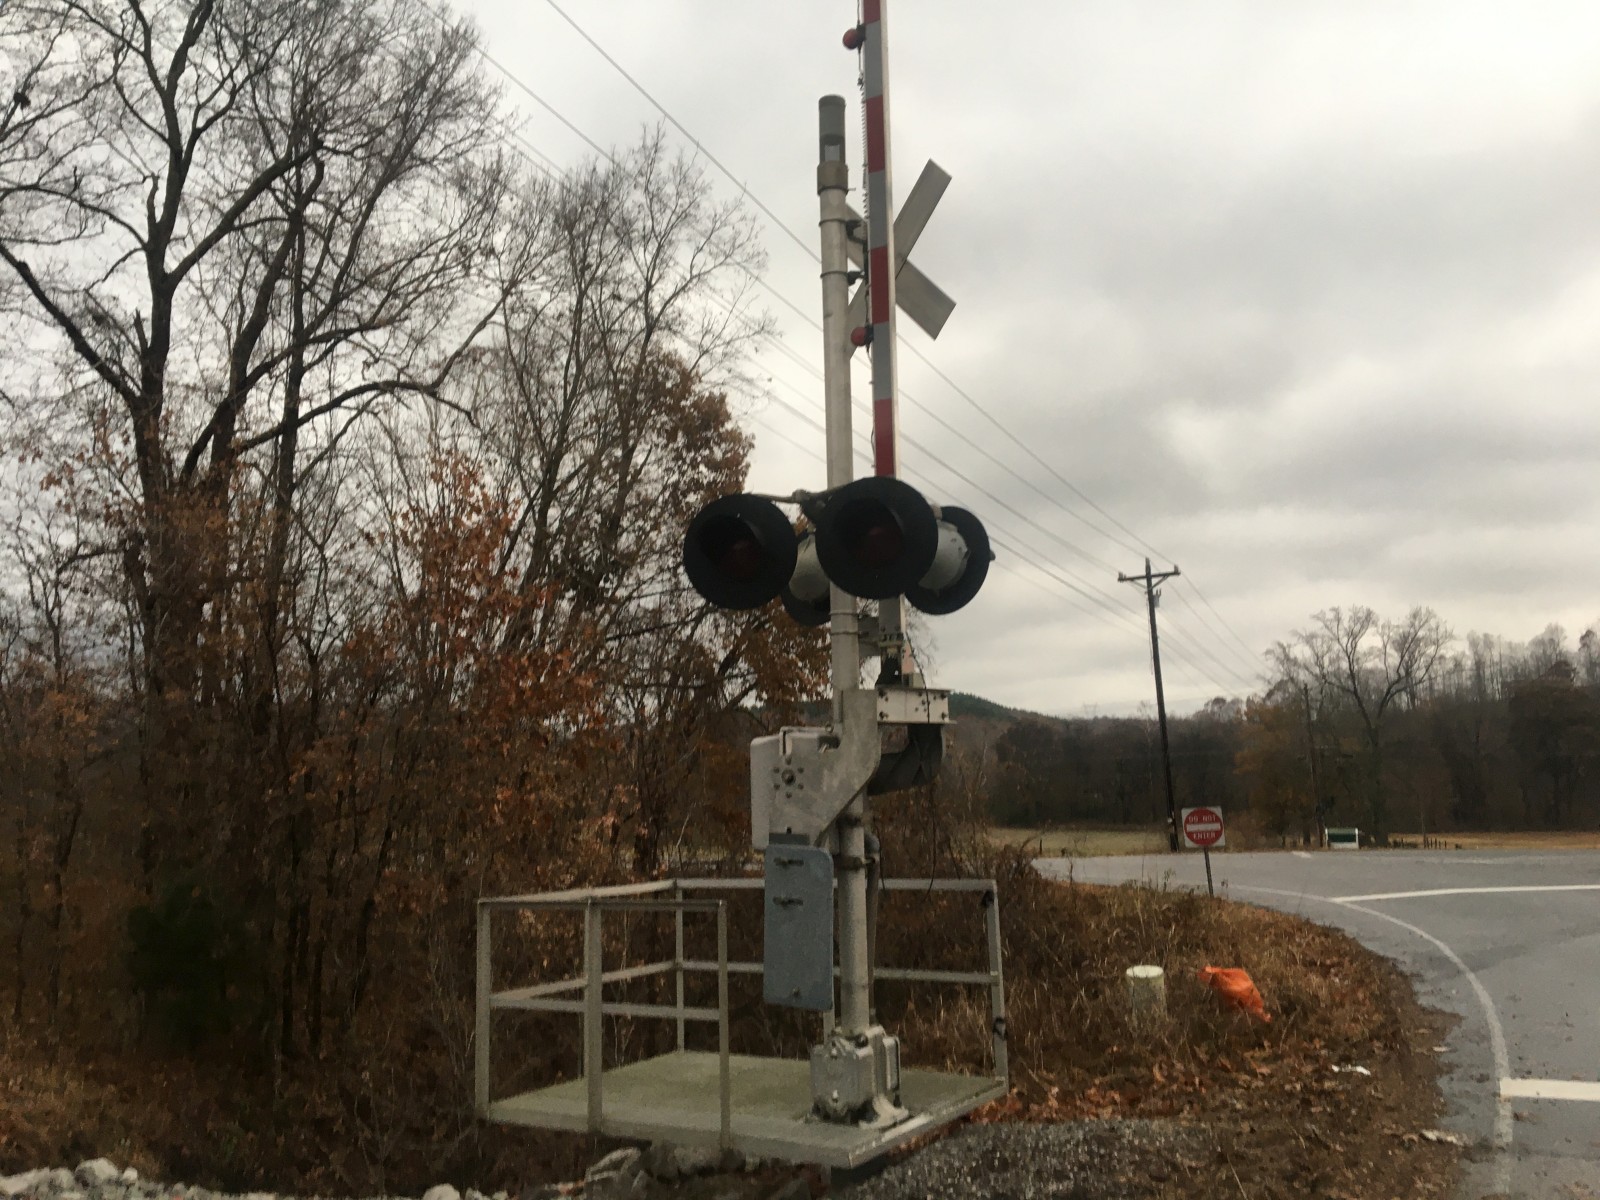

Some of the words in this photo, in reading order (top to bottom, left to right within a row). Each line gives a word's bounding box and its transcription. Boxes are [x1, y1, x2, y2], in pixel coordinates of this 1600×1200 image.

[1188, 815, 1199, 823] DO
[1202, 814, 1216, 822] NOT
[1193, 831, 1216, 840] ENTER
